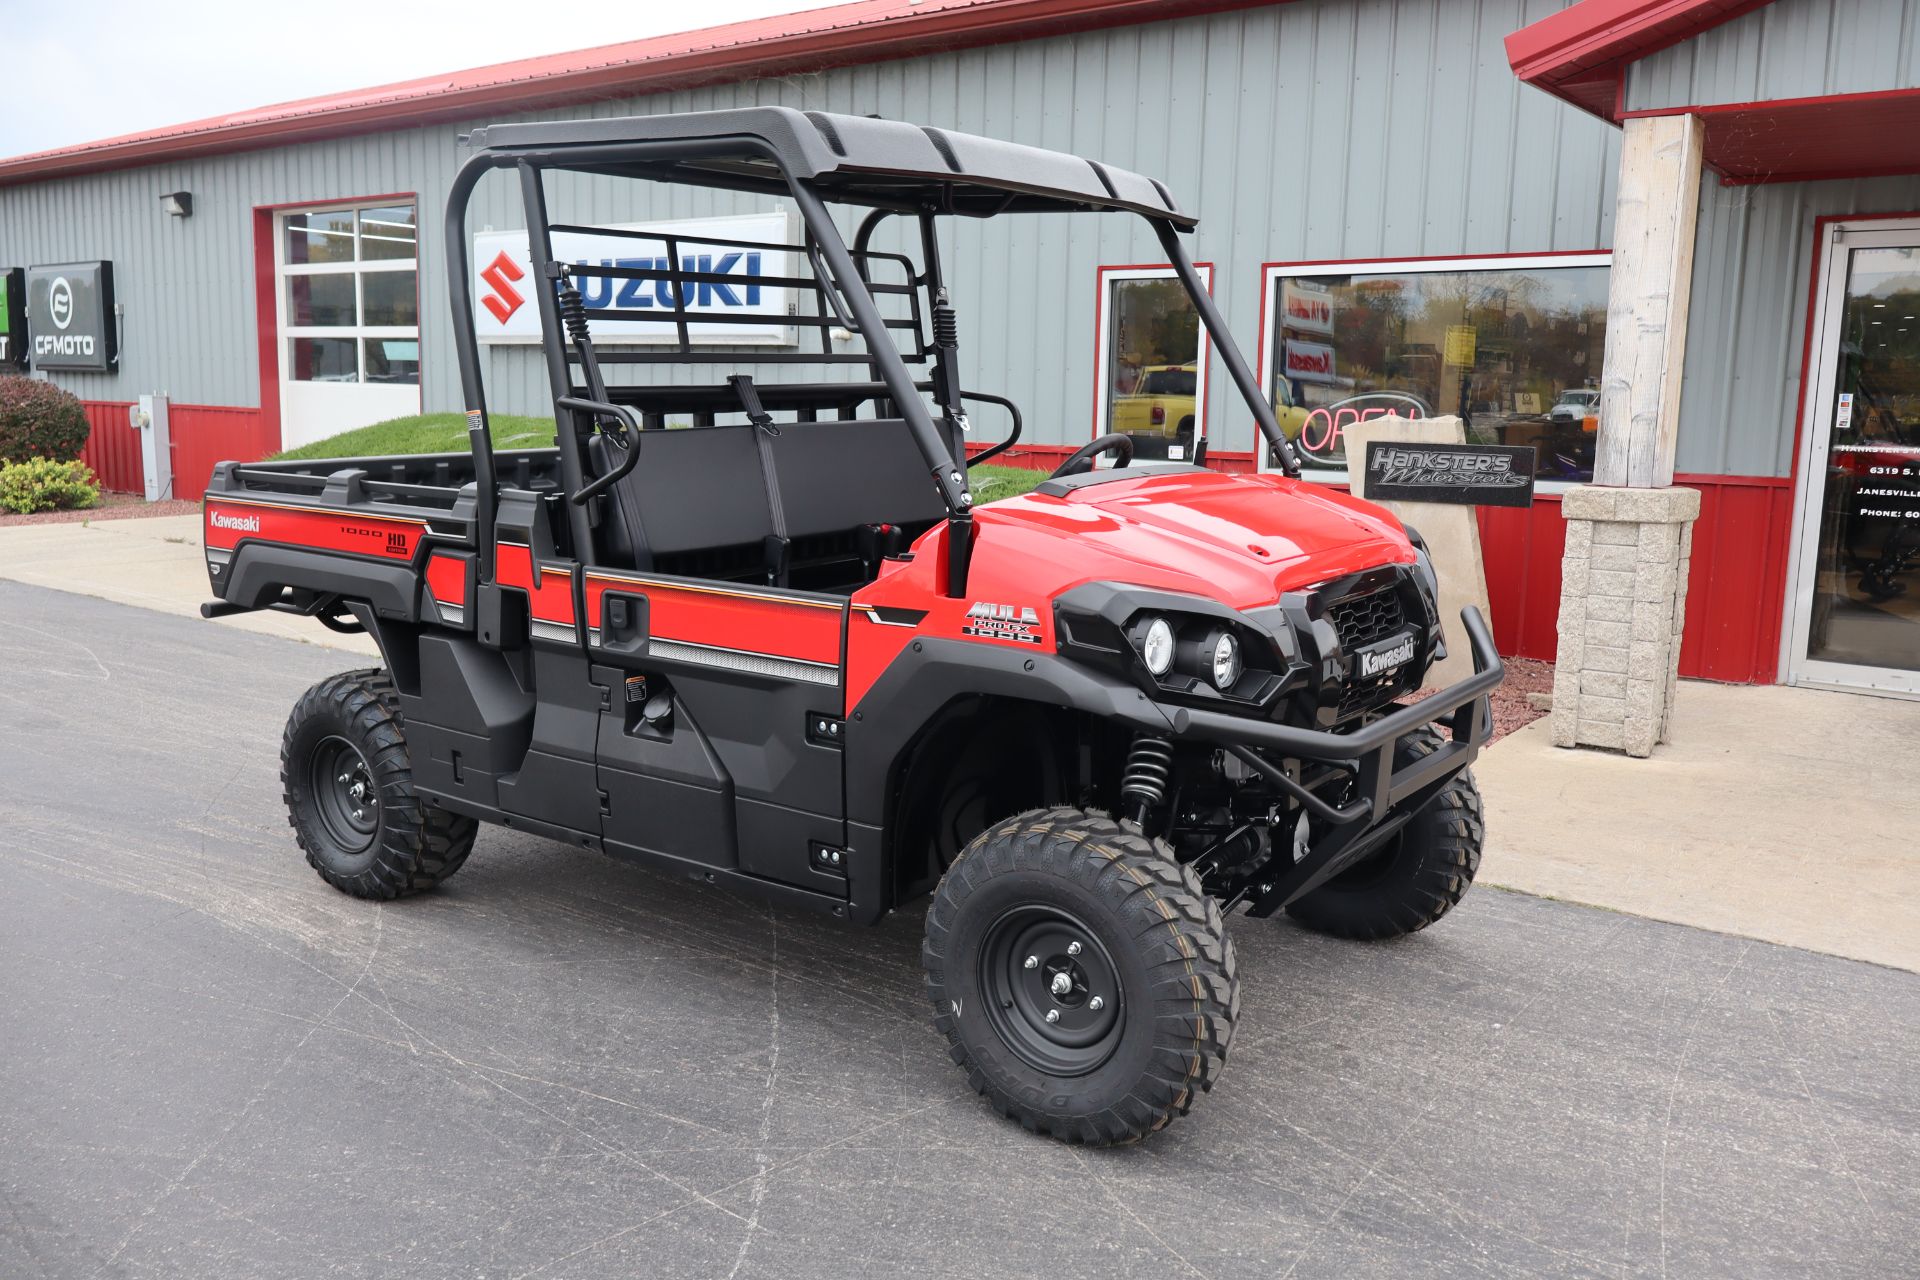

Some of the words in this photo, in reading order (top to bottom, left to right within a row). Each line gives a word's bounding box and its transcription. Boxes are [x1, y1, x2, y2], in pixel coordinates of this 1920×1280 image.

[557, 251, 761, 310] UZUKI
[35, 335, 94, 355] CFMOTO
[1869, 466, 1899, 475] 6319
[1860, 508, 1901, 518] PHONE:
[211, 511, 260, 533] Kawasaki
[340, 526, 383, 538] 1000
[388, 532, 406, 547] HD
[1362, 636, 1414, 677] Kawasaki
